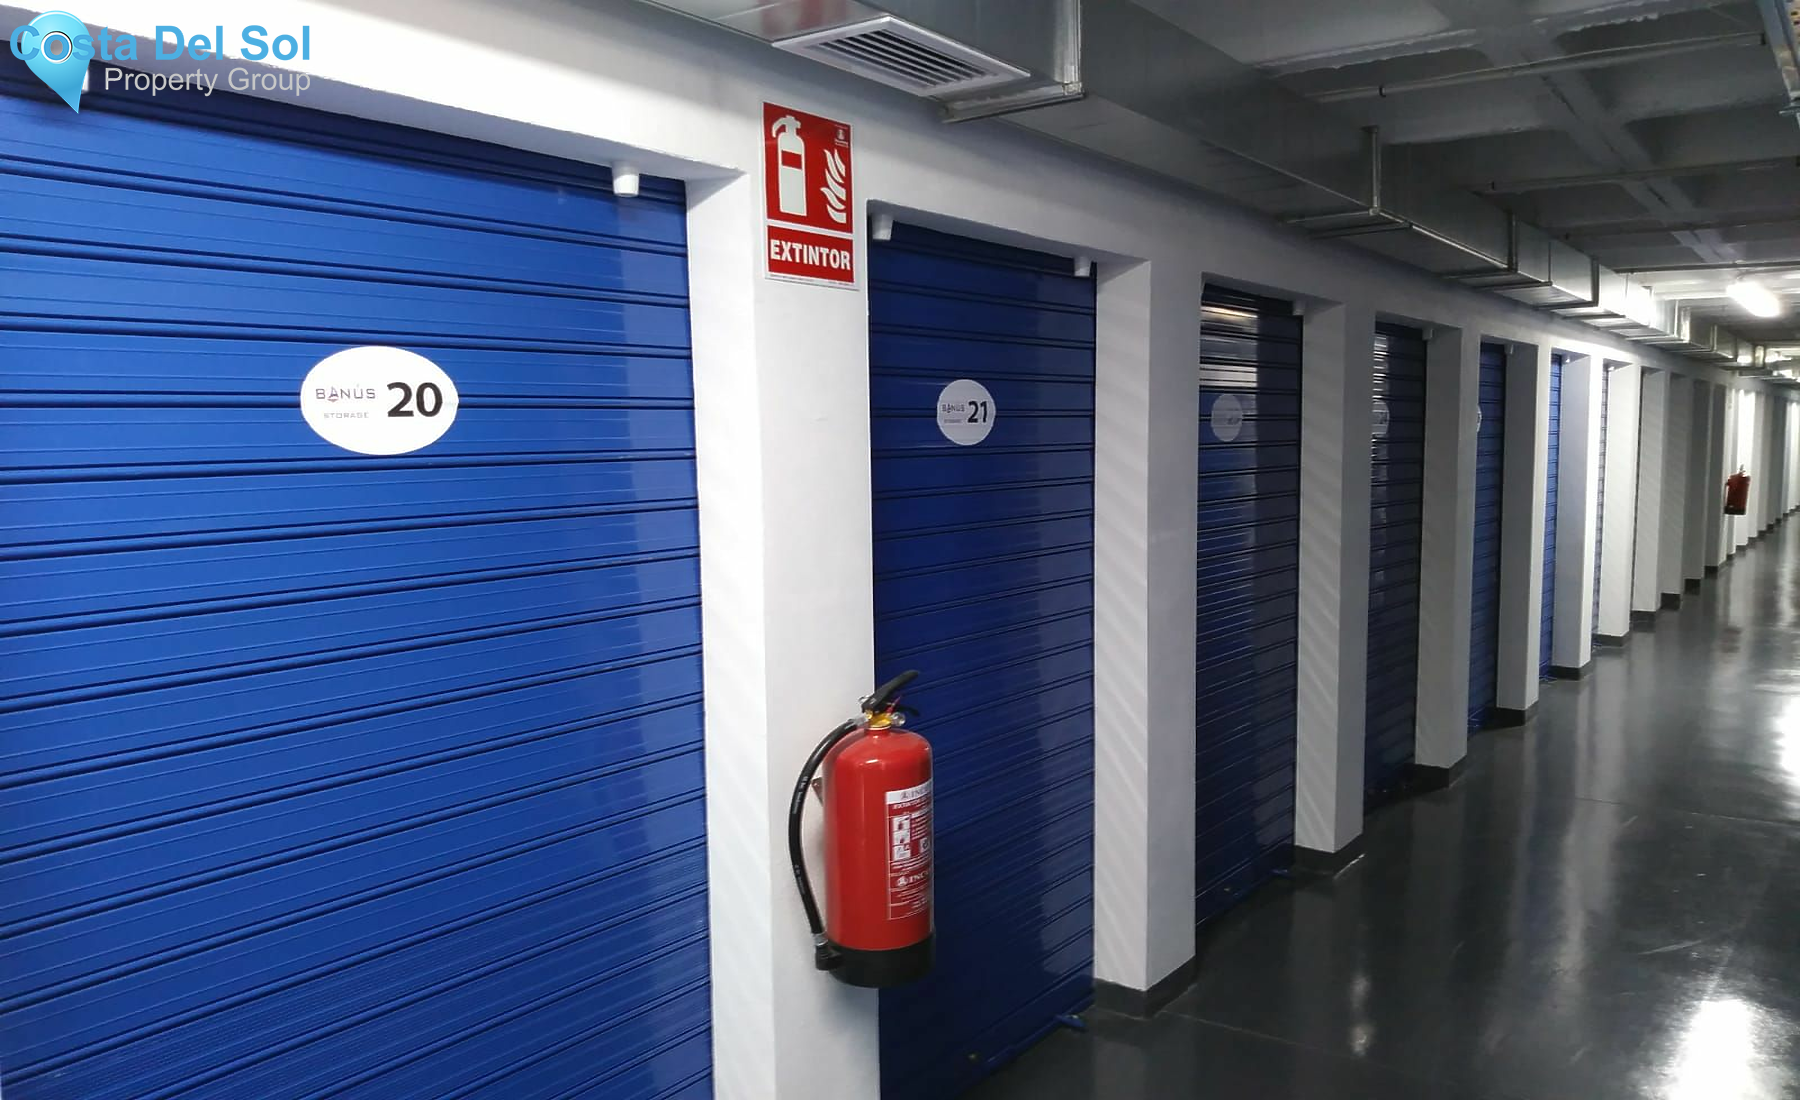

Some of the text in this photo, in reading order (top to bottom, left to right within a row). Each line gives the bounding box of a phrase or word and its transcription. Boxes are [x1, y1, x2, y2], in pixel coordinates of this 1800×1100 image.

[770, 239, 850, 270] EXTINTOR
[387, 382, 443, 417] 20
[968, 401, 987, 423] 21
